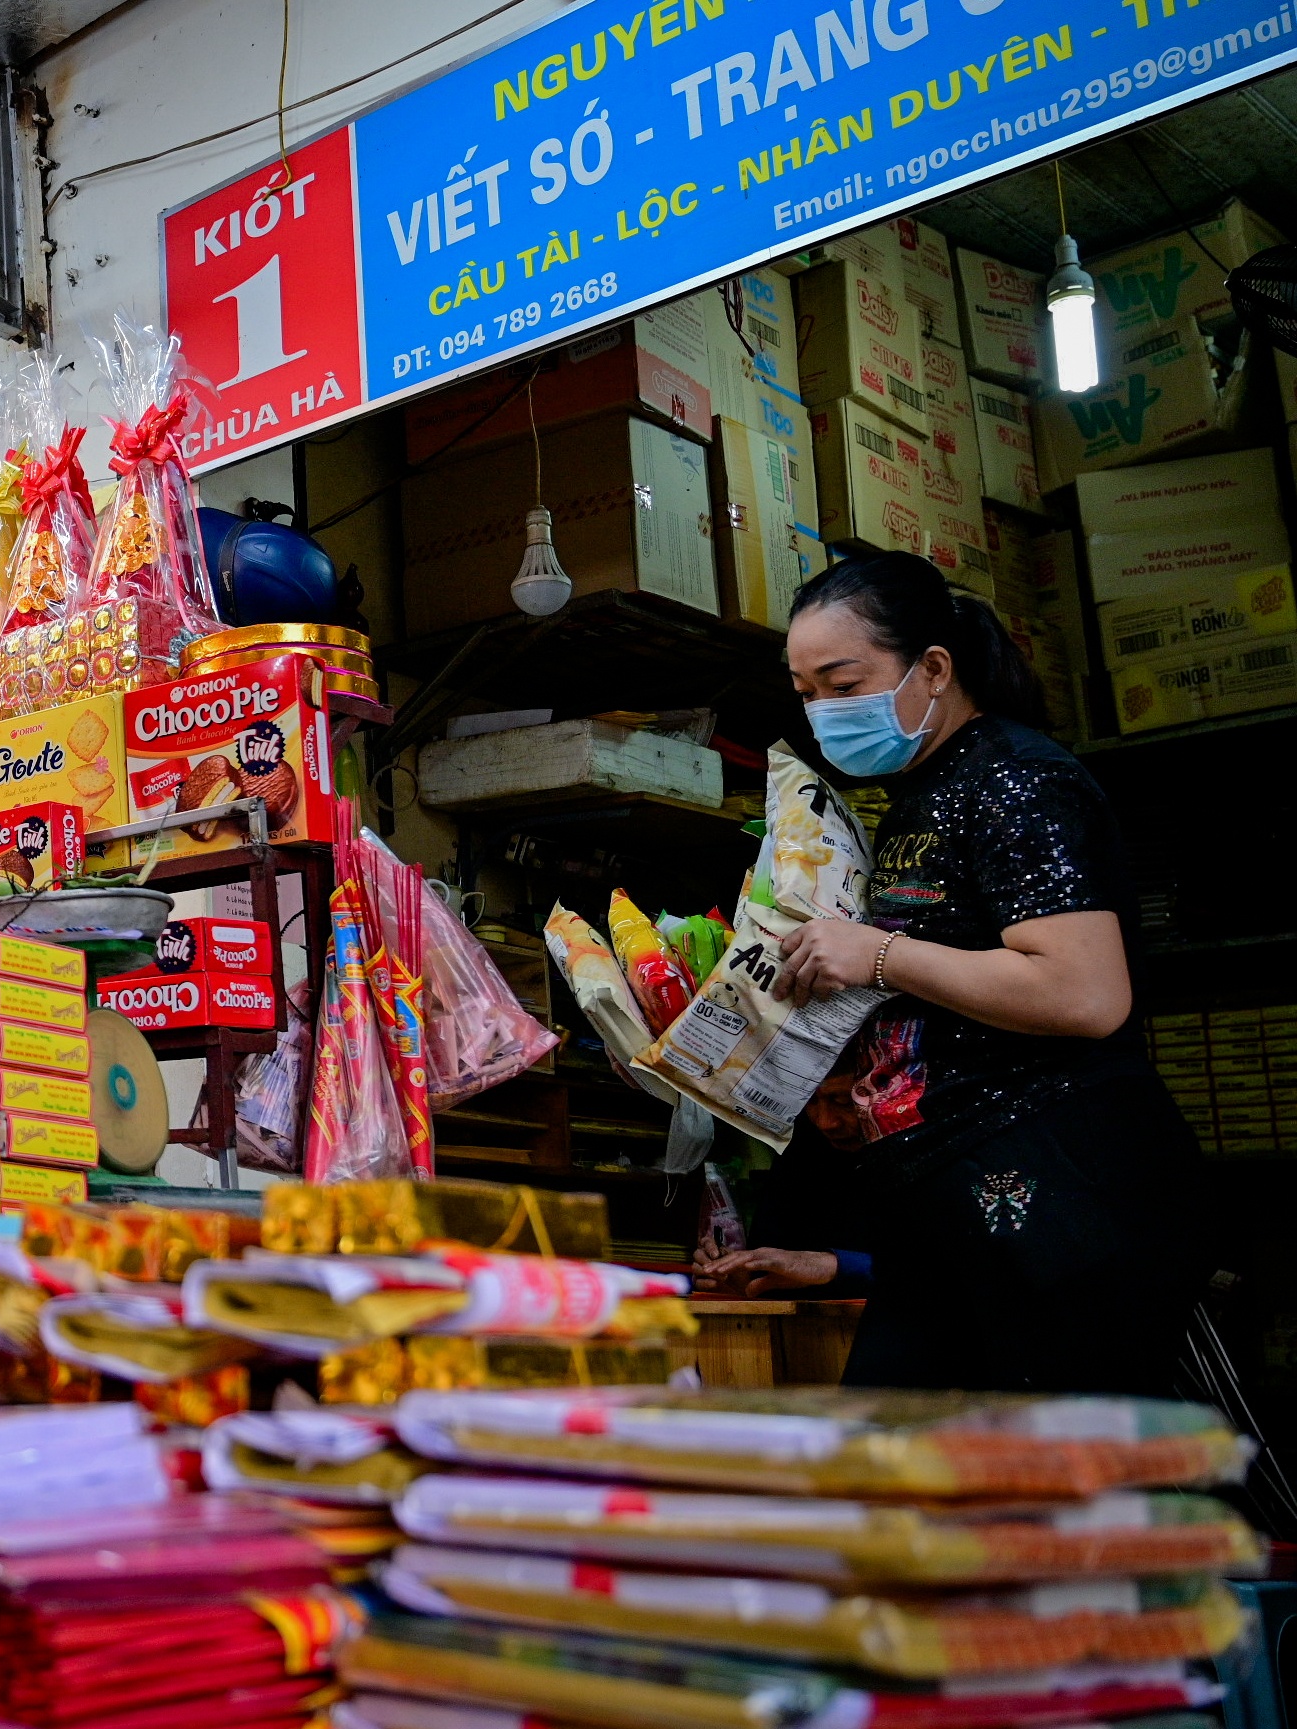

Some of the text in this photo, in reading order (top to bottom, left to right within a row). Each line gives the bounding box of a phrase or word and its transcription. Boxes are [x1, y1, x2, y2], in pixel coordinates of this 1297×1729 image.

[386, 145, 509, 267] VIẾT
[529, 98, 614, 205] SỚ
[428, 254, 506, 317] CẦU
[516, 229, 580, 284] TÀI
[616, 181, 699, 242] LỘC
[738, 108, 874, 191] NHÂN
[888, 24, 1074, 129] DUYÊN
[773, 174, 875, 231] Email:
[194, 170, 316, 267] KIỐT
[211, 252, 308, 391] 1
[438, 324, 486, 361] 094
[493, 301, 542, 341] 789
[550, 272, 618, 318] 2668
[181, 372, 345, 460] CHÙA HÀ
[18, 724, 44, 737] ORION
[135, 682, 280, 742] ChocoPie
[187, 674, 237, 699] ORION
[215, 988, 273, 1010] ChocoPie
